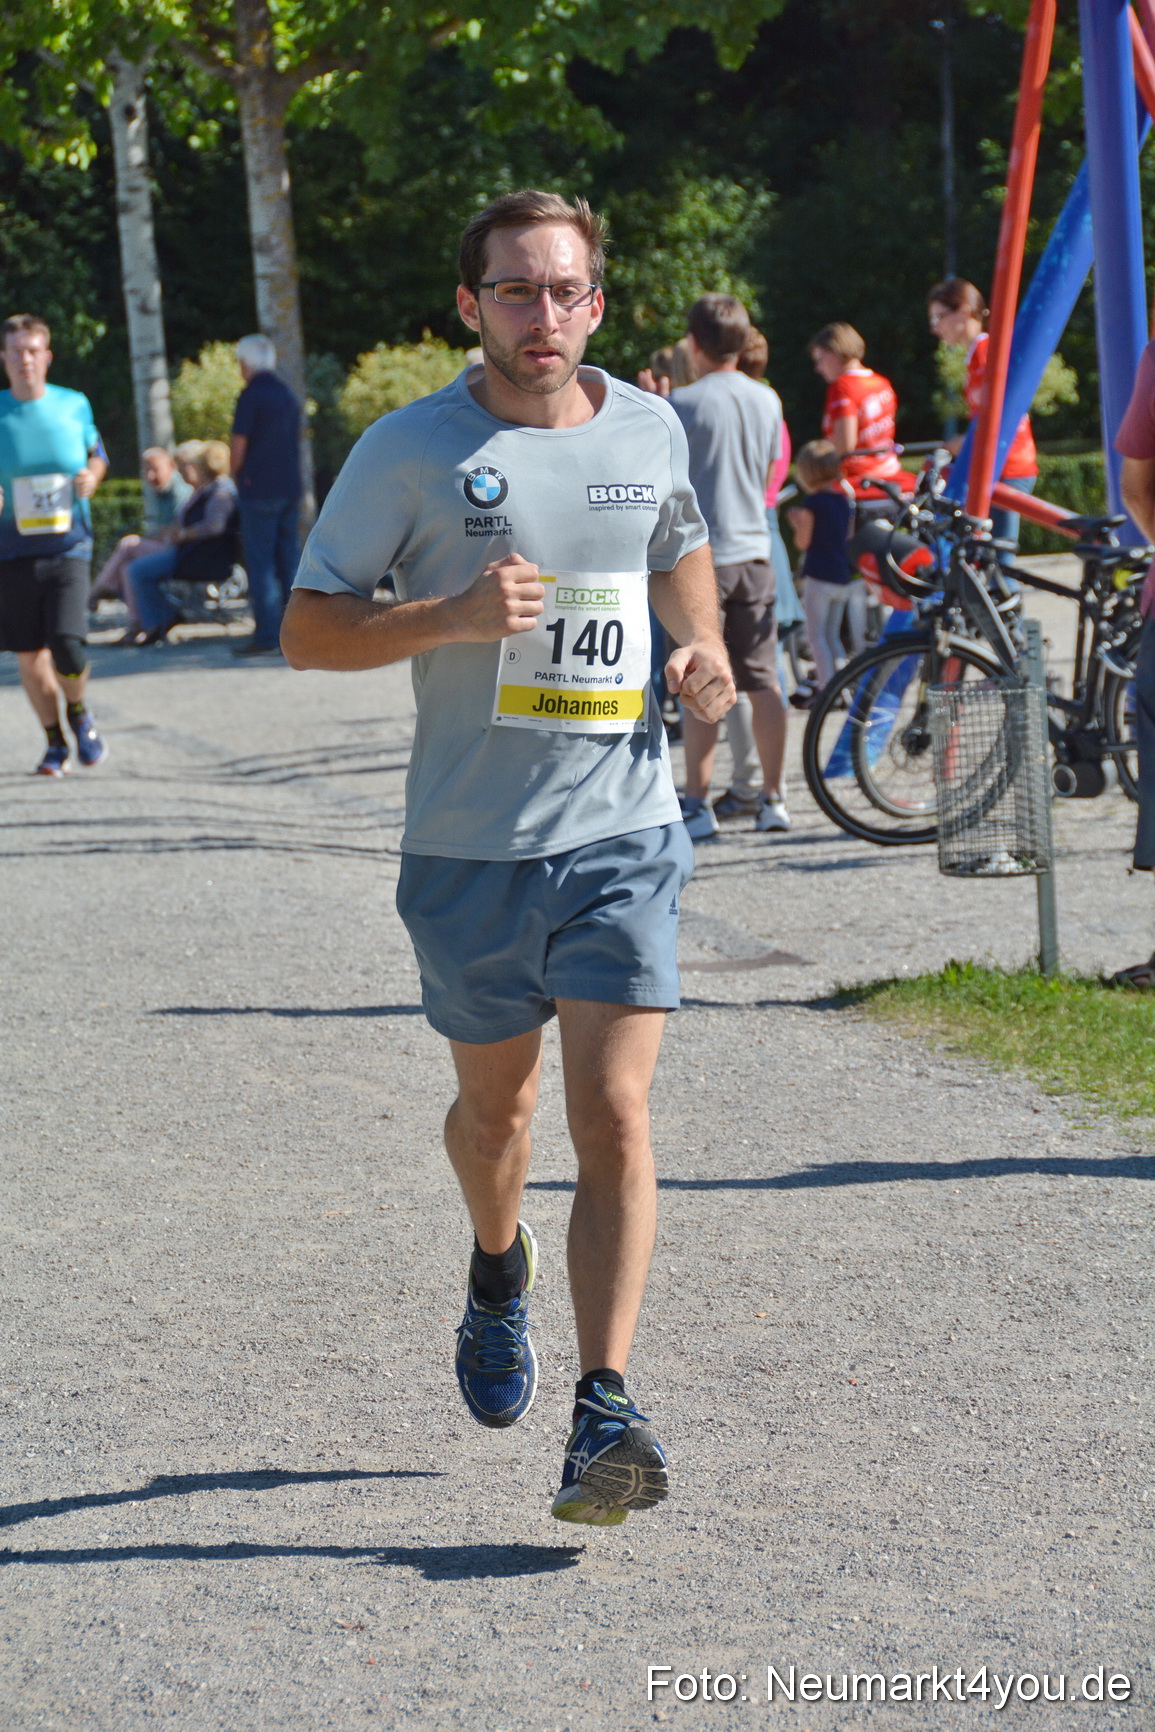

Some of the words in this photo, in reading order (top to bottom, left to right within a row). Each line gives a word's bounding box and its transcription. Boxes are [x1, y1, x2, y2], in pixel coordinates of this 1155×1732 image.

[466, 467, 505, 482] BMW
[587, 484, 657, 504] BOCK
[588, 504, 615, 512] inspired
[616, 504, 623, 512] by
[464, 515, 512, 529] PARTL
[465, 527, 513, 537] Neumarkt
[556, 587, 620, 605] BOCK
[554, 603, 579, 611] inspired
[578, 604, 585, 612] by
[546, 618, 624, 667] 140
[509, 651, 516, 661] D
[534, 671, 569, 683] PARTL
[571, 674, 613, 684] Neumarkt
[532, 693, 619, 716] Johannes
